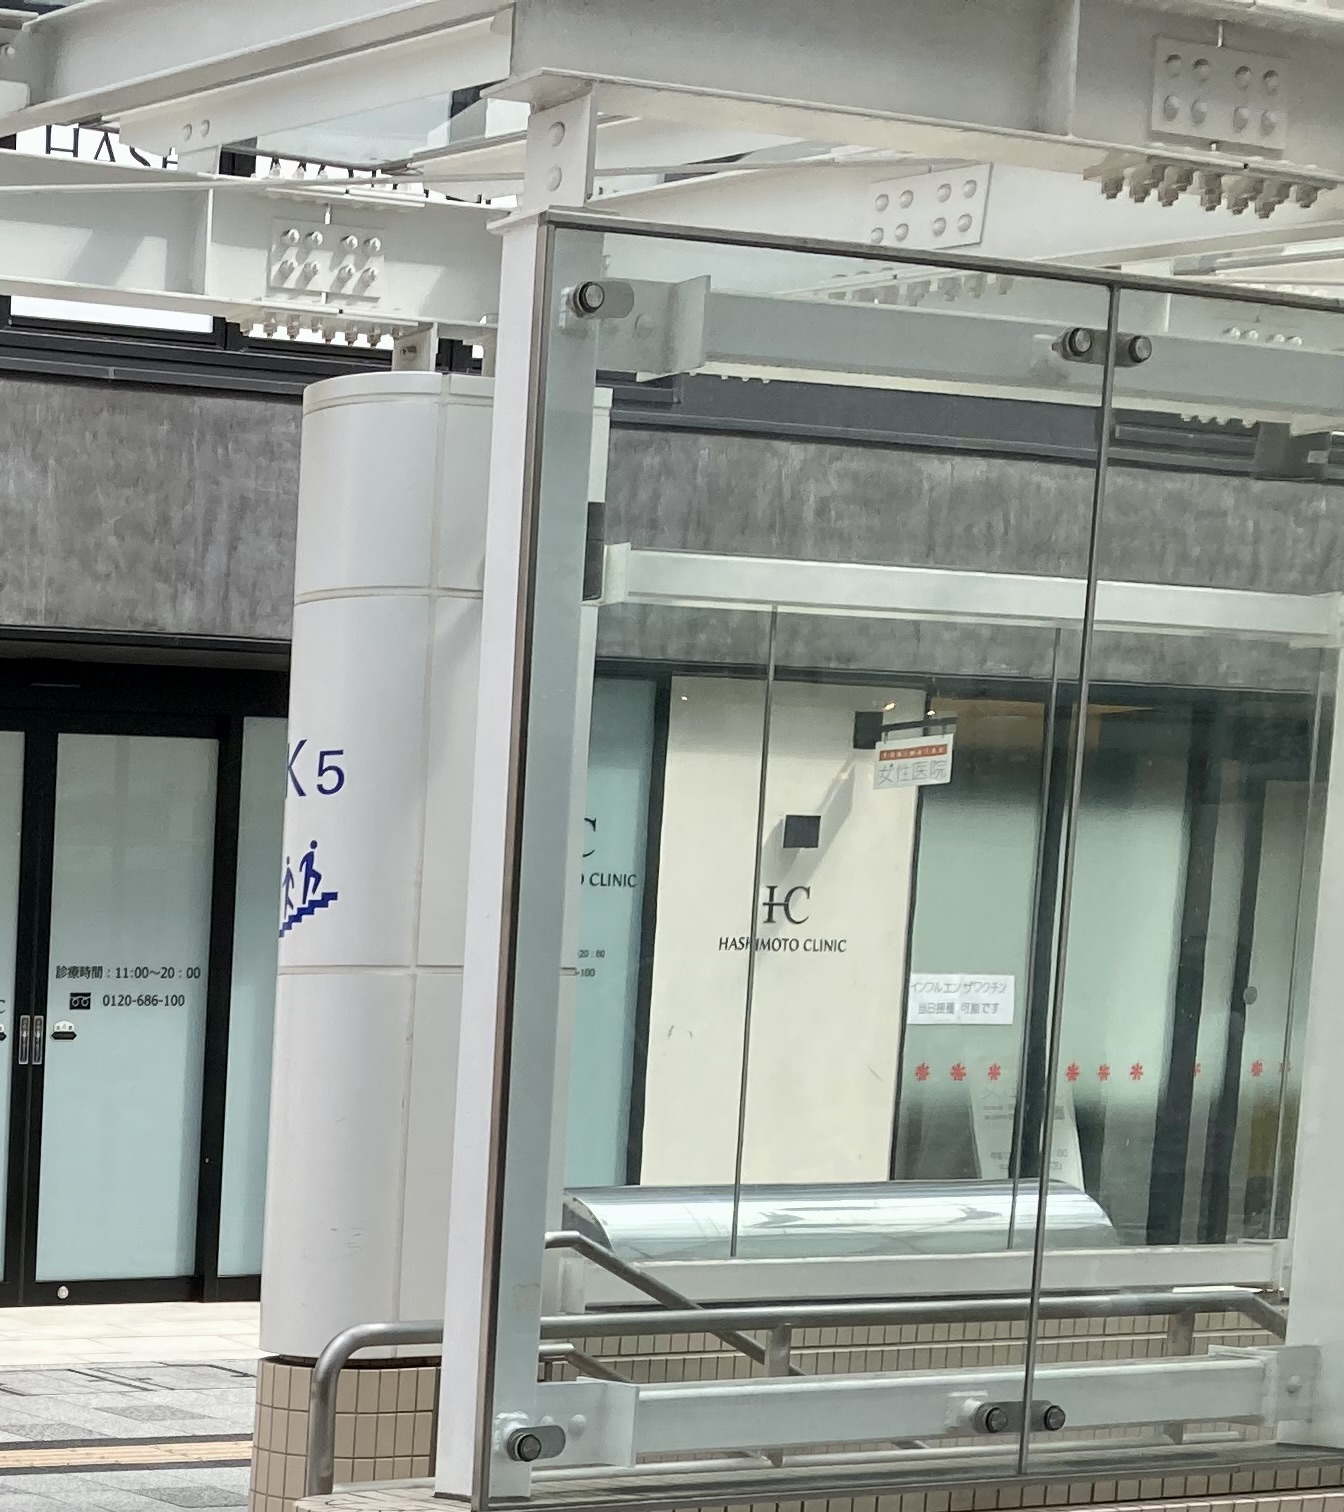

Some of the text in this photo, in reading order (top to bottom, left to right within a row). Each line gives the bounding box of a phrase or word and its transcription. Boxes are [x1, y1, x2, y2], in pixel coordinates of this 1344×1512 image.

[878, 760, 948, 785] 女性医院
[588, 872, 639, 888] CLINIC
[803, 938, 847, 953] CLINIC
[102, 994, 185, 1007] 0120-686-100
